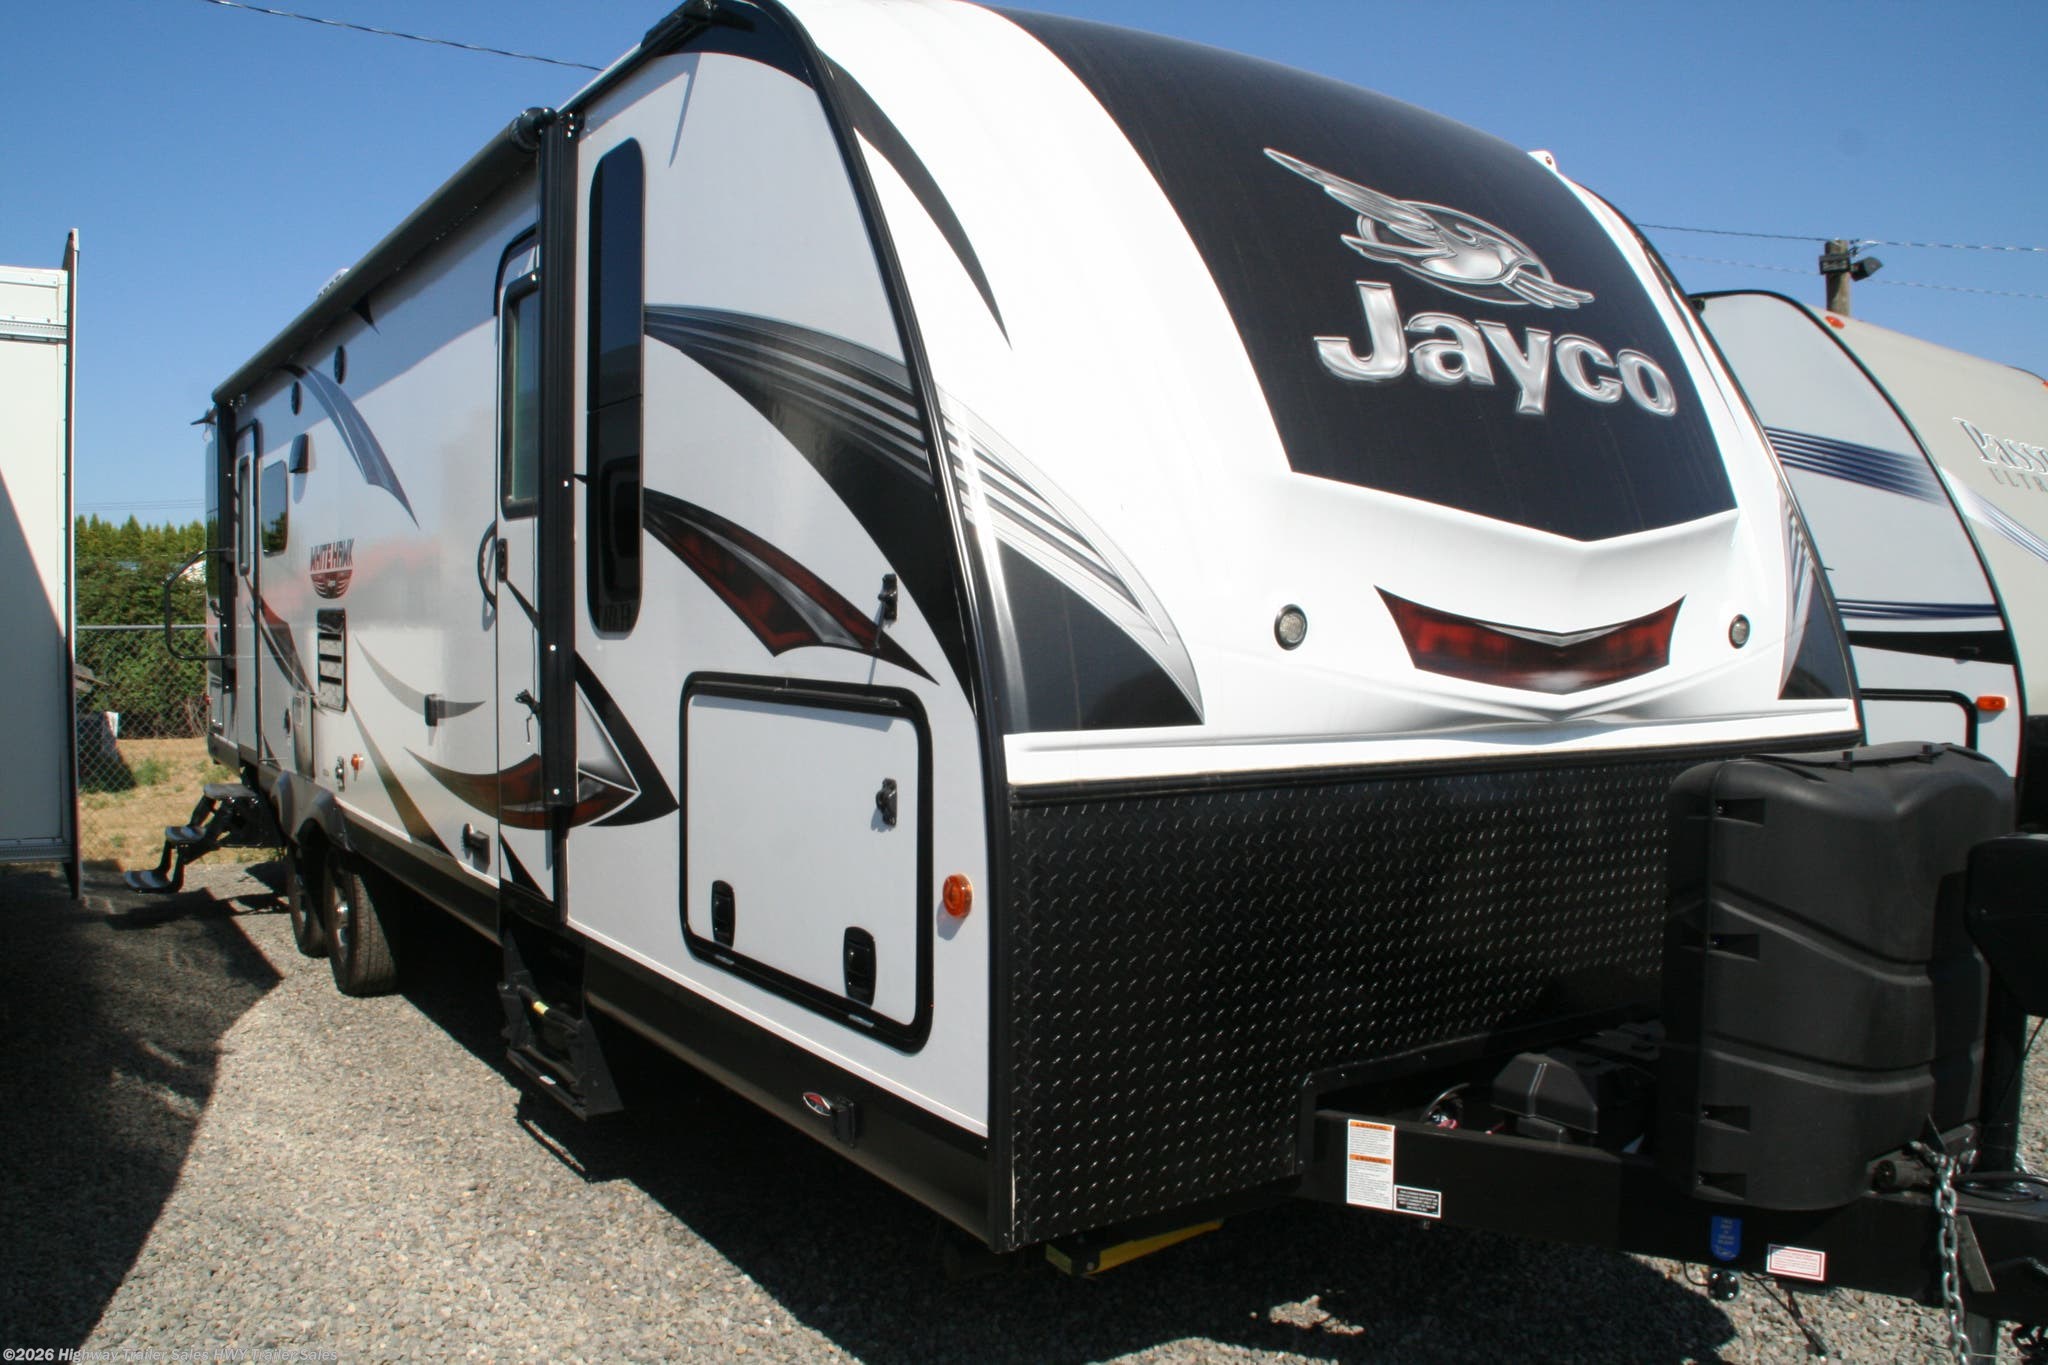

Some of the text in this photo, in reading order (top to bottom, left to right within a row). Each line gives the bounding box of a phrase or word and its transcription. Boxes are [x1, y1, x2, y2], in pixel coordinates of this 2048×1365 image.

[1313, 280, 1678, 417] Jayco
[310, 537, 355, 572] WHITE HAWK
